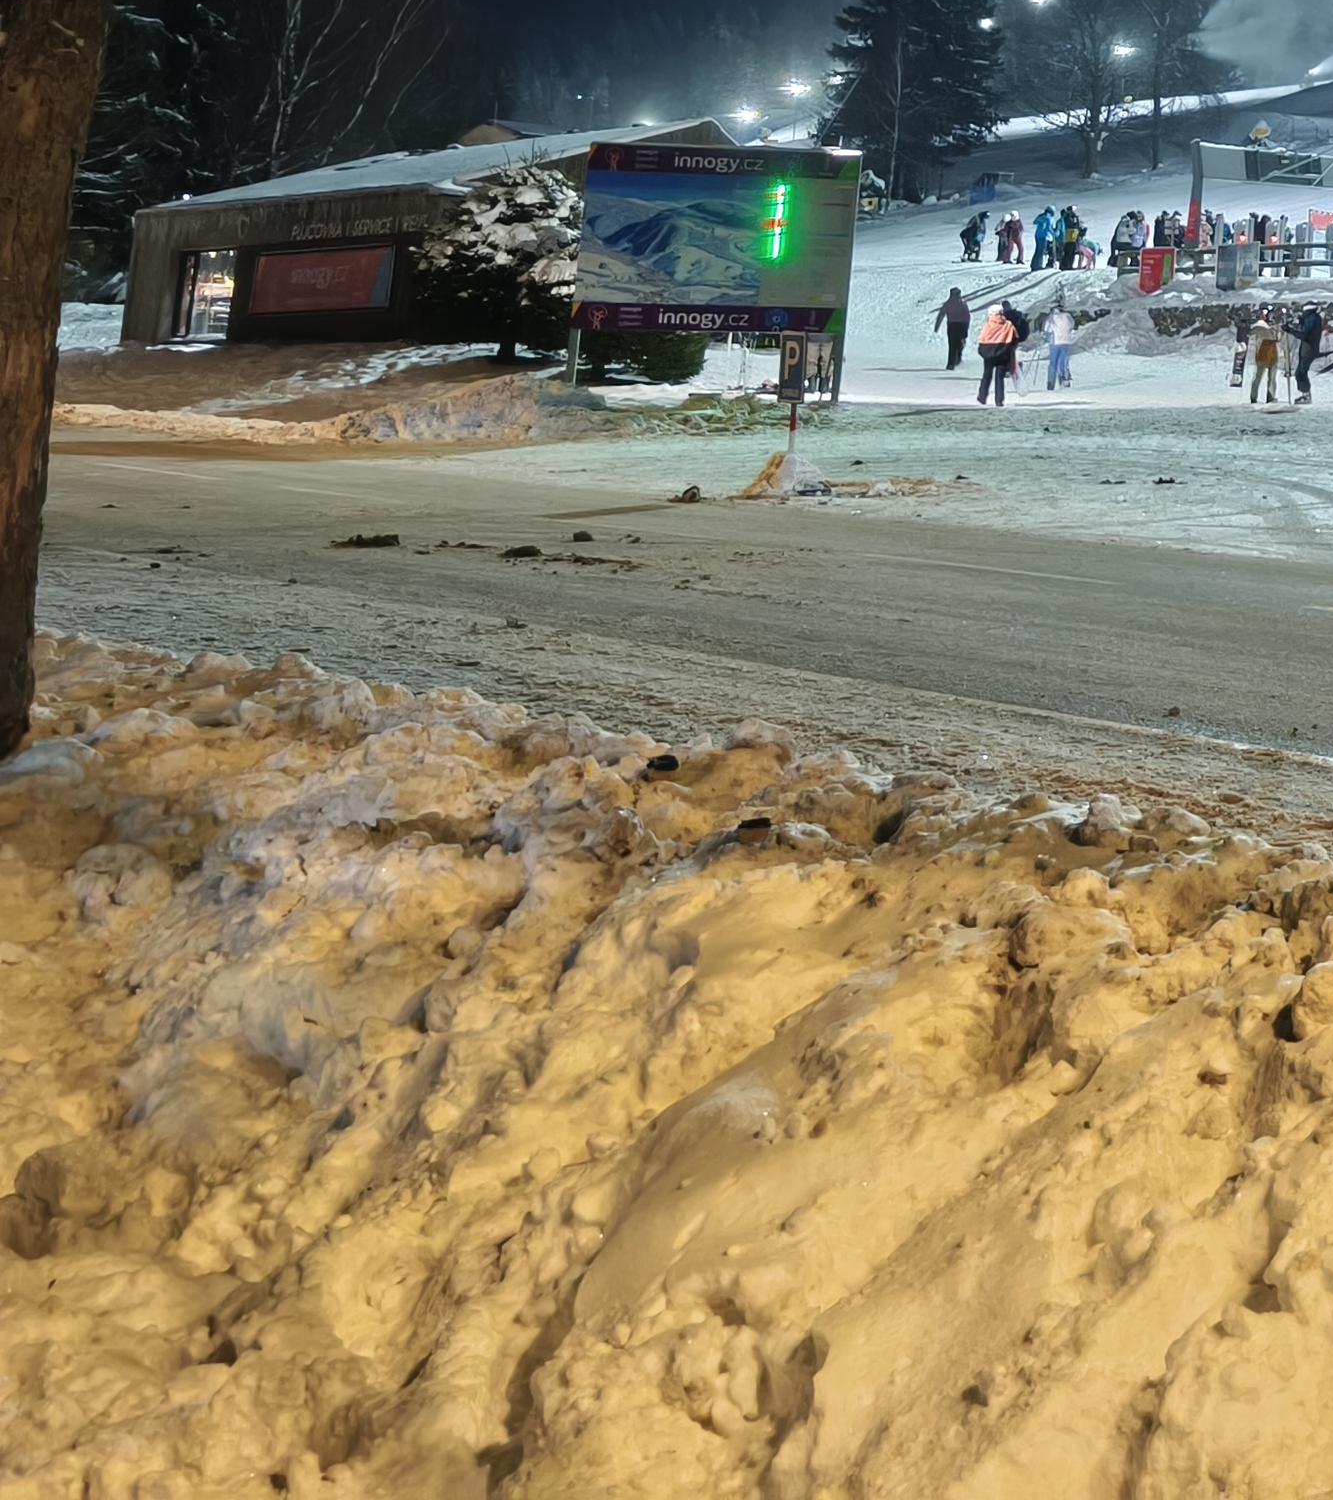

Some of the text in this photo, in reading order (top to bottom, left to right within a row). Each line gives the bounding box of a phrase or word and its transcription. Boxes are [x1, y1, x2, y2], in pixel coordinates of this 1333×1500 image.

[674, 151, 765, 173] innogy.cz
[658, 308, 750, 330] innogy.cz
[784, 340, 800, 381] P
